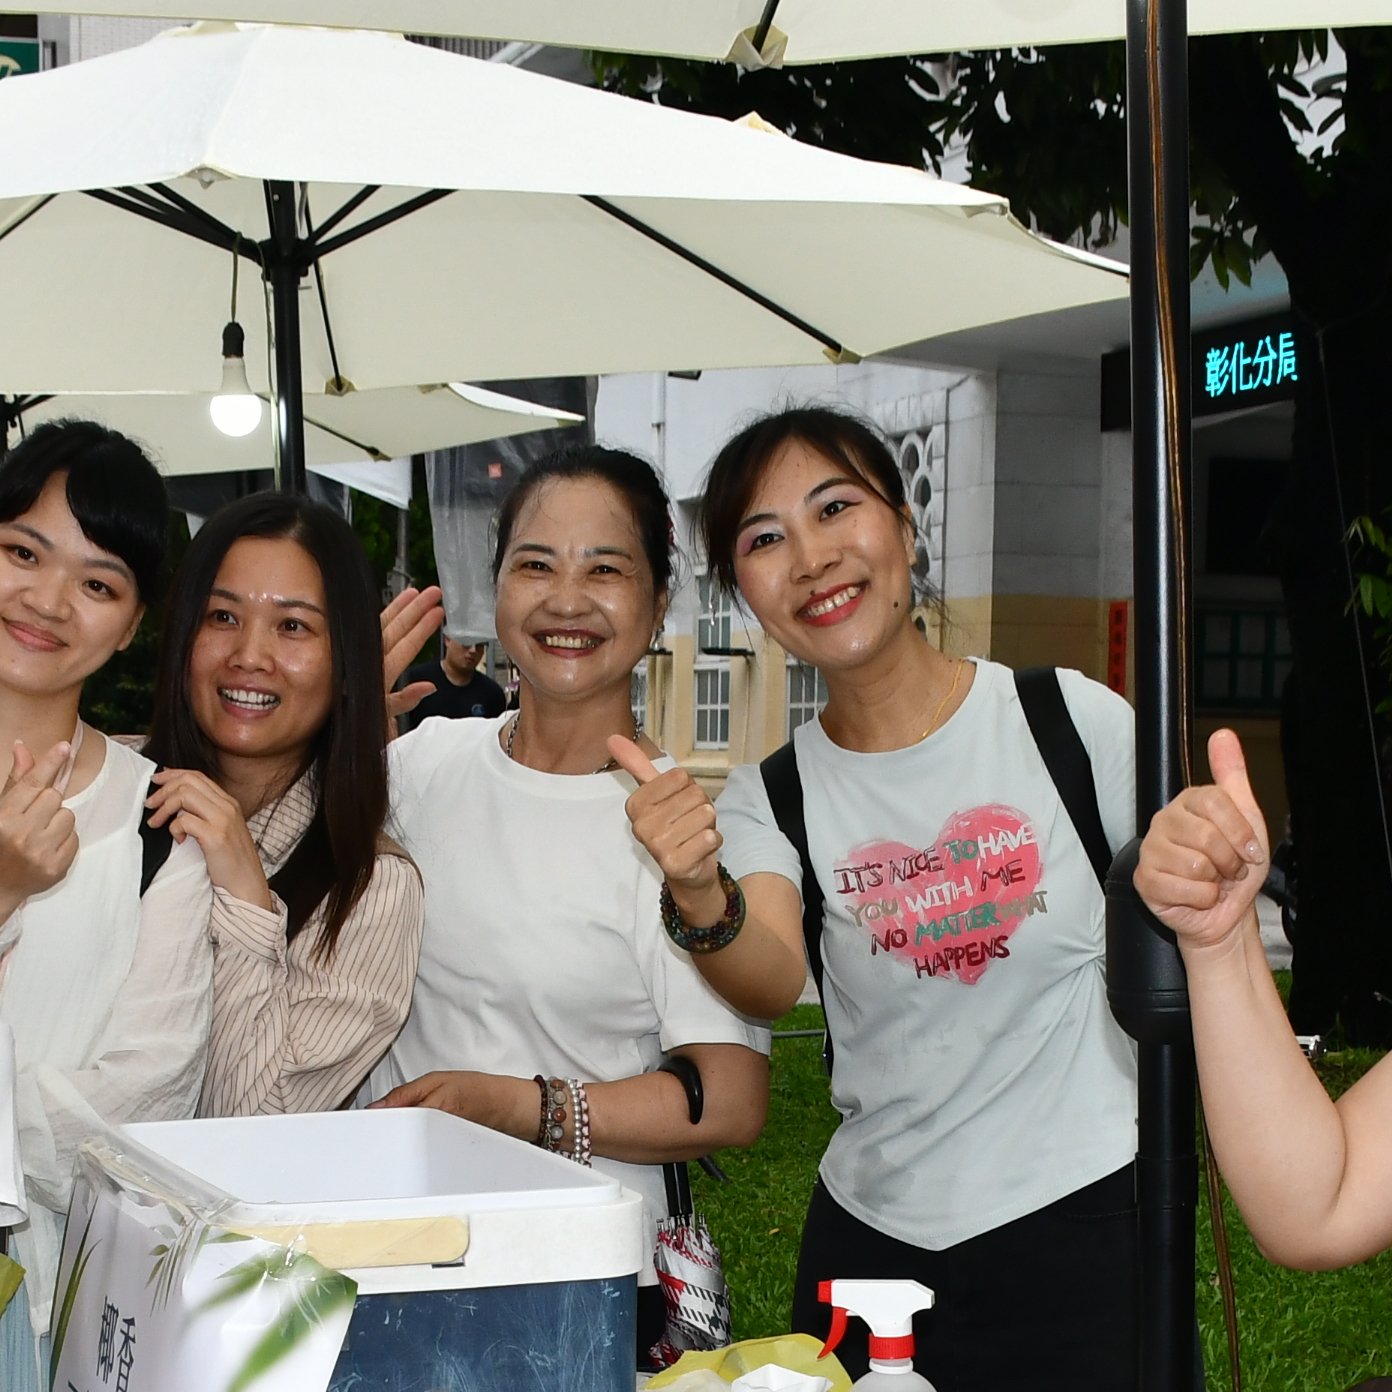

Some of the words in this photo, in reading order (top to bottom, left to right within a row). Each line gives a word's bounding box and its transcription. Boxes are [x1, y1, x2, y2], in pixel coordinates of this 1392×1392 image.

[1205, 332, 1298, 398] 彰化分局
[833, 861, 884, 895] IT'S
[888, 846, 945, 884] NICE
[943, 838, 978, 864] TO
[976, 820, 1038, 859] HAVE
[845, 897, 899, 928] YOU
[904, 876, 975, 917] WITH
[980, 859, 1027, 892] ME
[870, 928, 908, 956] NO
[914, 904, 1002, 947] MATTER
[999, 890, 1049, 922] WHAT
[912, 934, 1011, 980] HAPPENS
